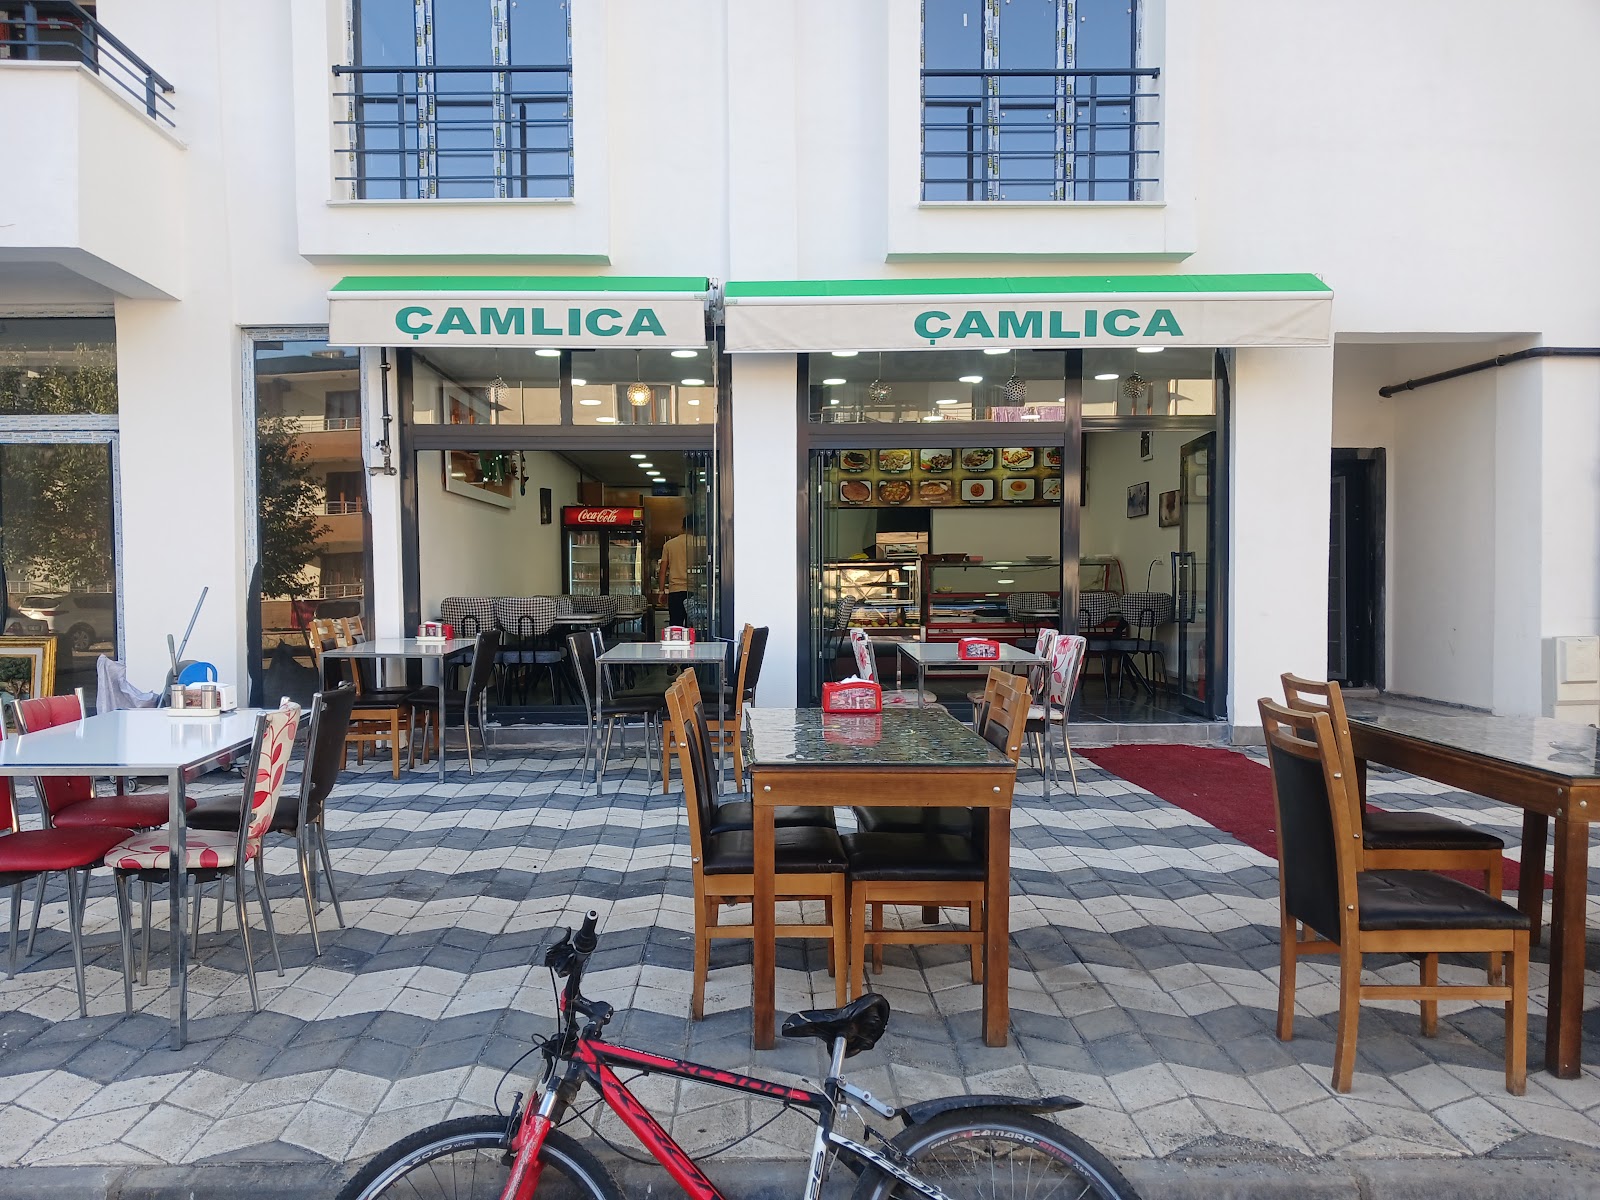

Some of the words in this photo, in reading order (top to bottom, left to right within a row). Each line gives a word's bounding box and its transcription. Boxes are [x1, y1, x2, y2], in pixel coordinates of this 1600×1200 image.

[395, 306, 667, 340] ÇAMLICA
[914, 309, 1184, 346] ÇAMLICA
[578, 509, 619, 523] Coca-Cola
